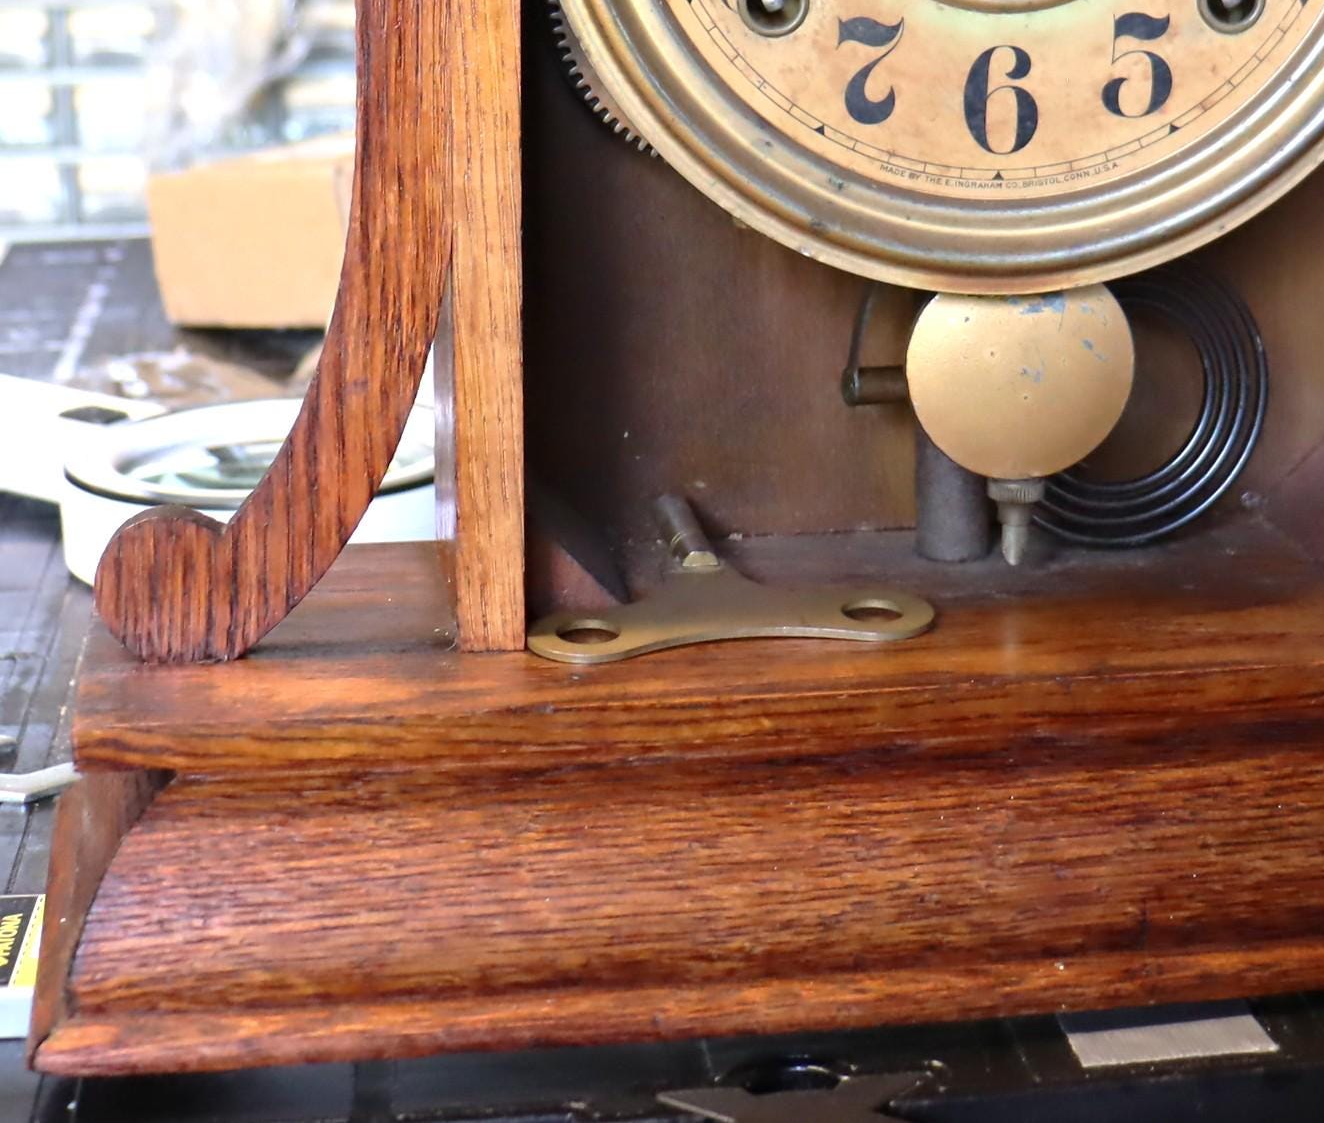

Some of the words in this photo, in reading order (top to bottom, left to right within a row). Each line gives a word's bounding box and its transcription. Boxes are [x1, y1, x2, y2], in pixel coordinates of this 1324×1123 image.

[836, 16, 904, 125] 7
[964, 45, 1038, 155] 6
[1102, 12, 1173, 118] 5
[880, 164, 906, 178] MADE
[908, 172, 922, 181] BY
[925, 175, 943, 185] THE
[955, 181, 1002, 189] INGRAHAM
